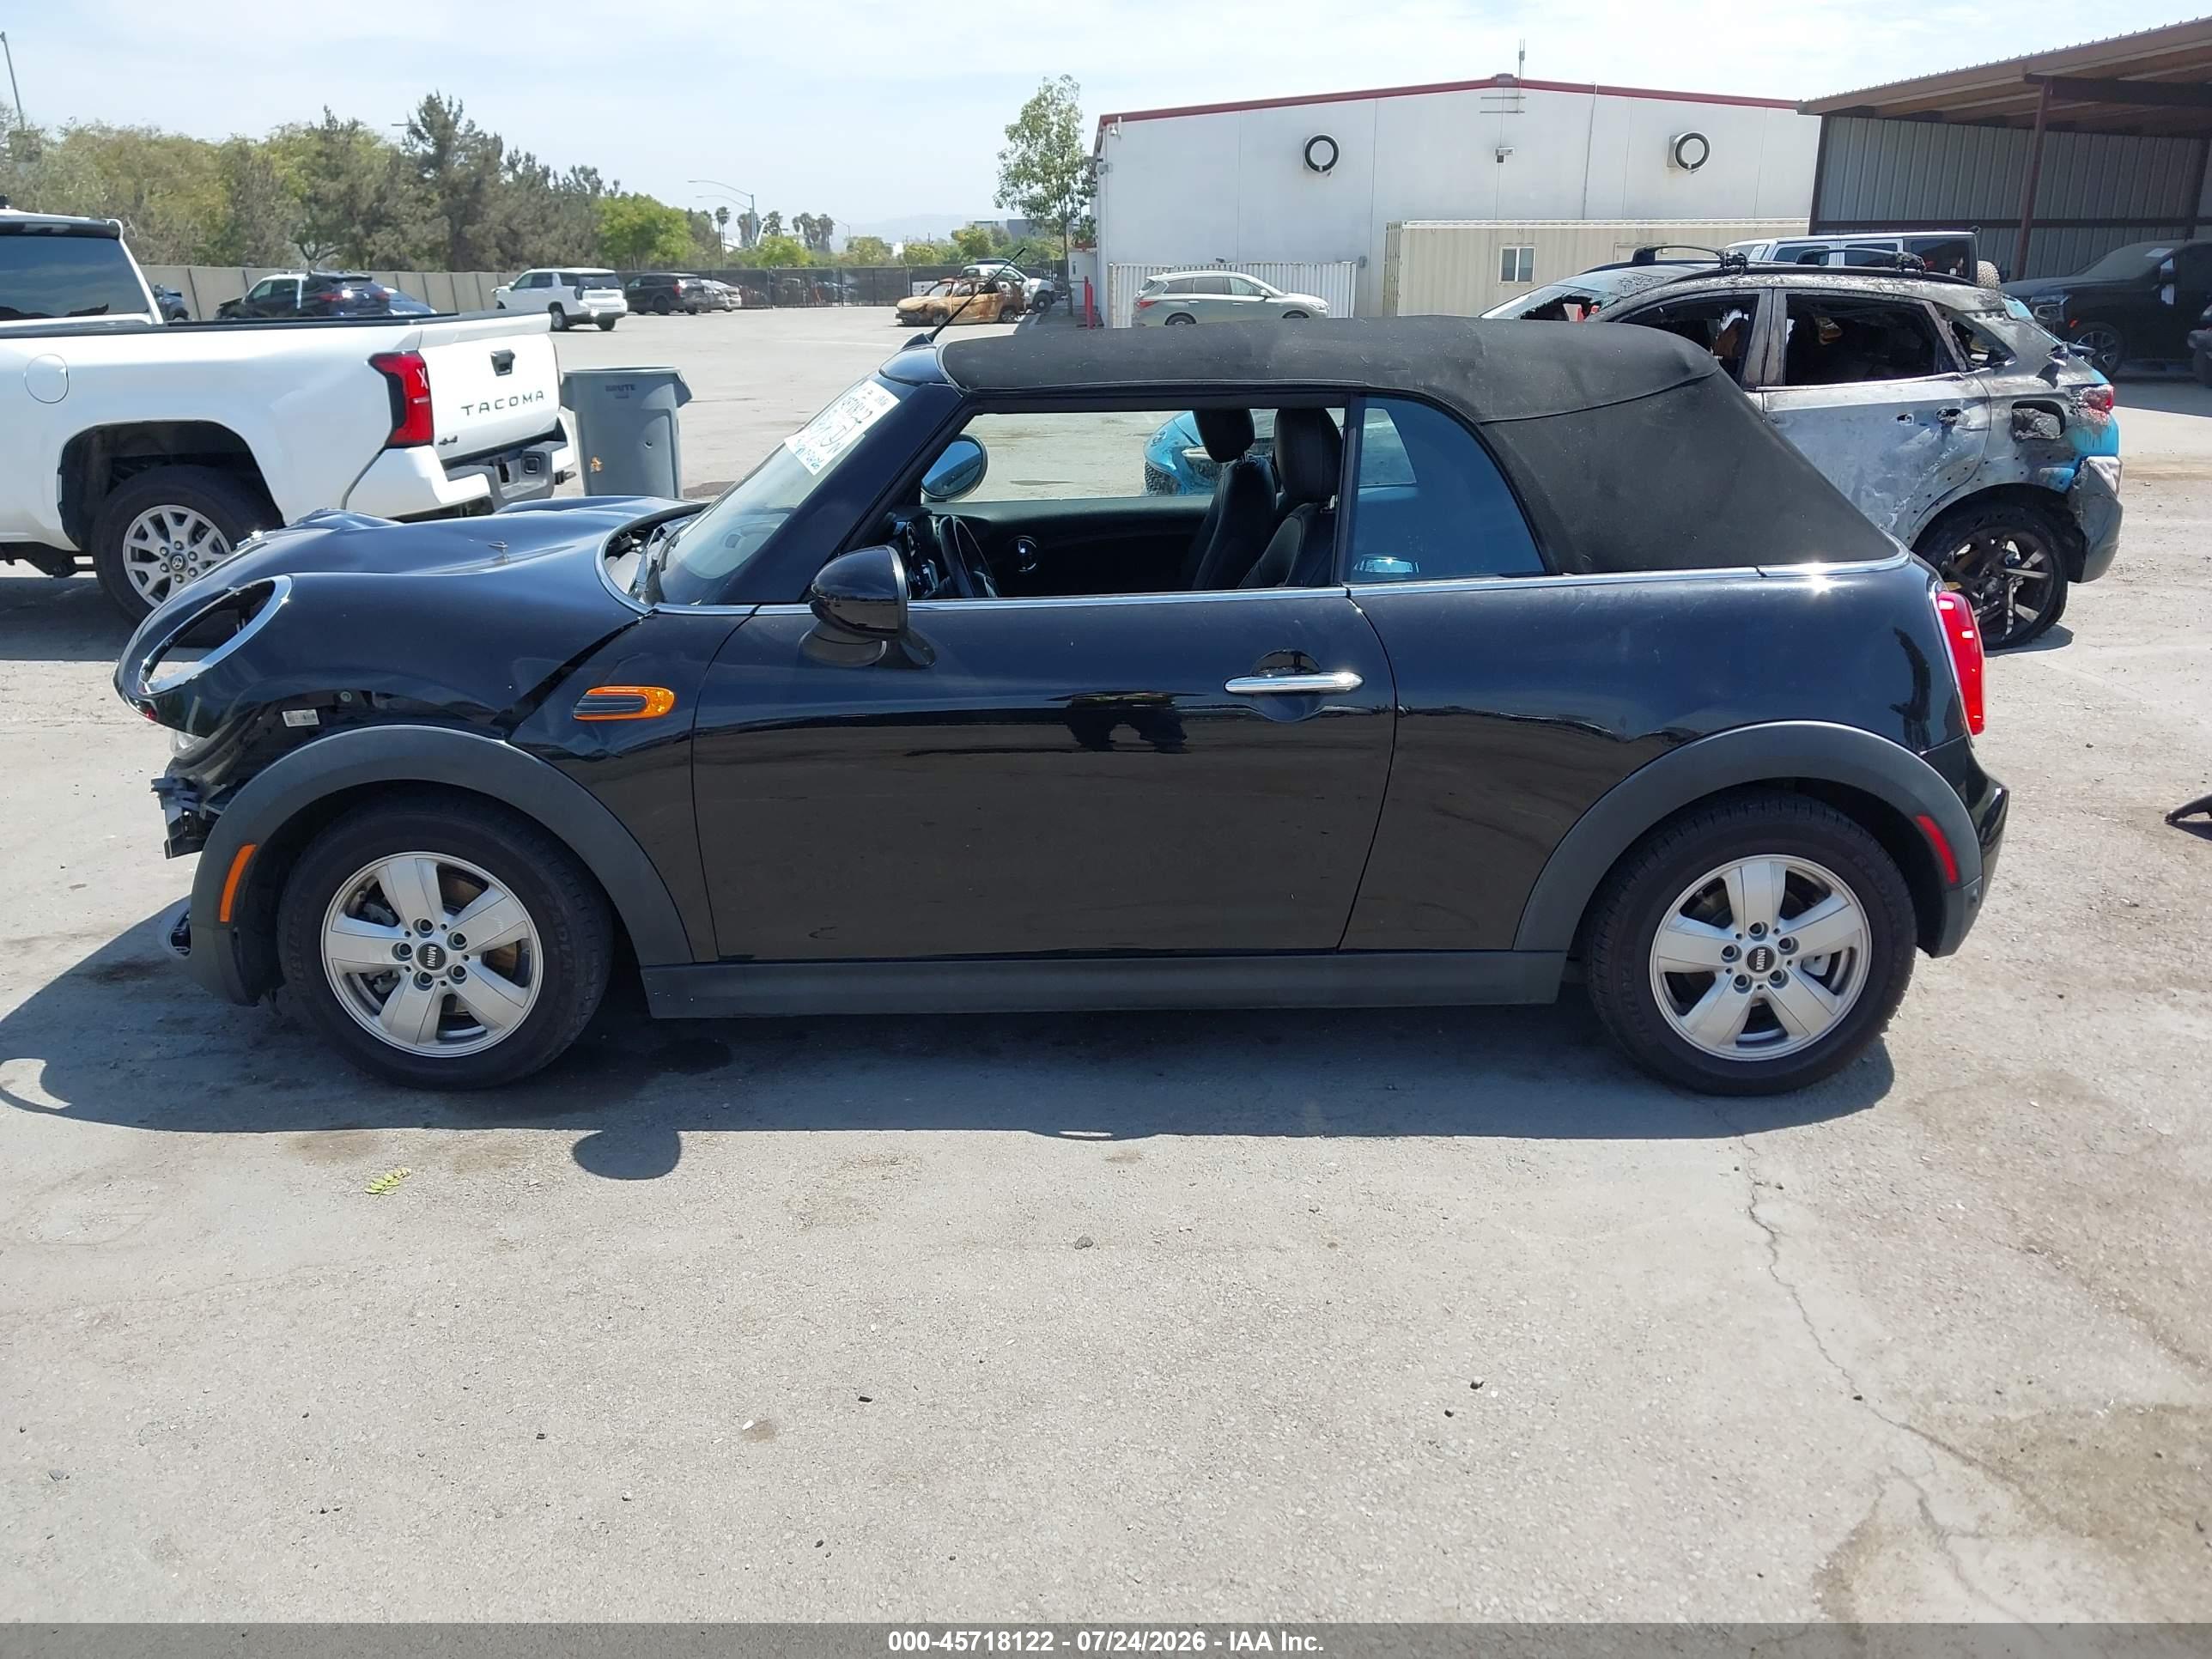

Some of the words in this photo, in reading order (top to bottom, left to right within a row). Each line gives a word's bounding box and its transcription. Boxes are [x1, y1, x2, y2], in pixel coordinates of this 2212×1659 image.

[460, 390, 544, 416] TACOMA
[427, 945, 437, 967] MINI
[1755, 949, 1766, 970] MINI
